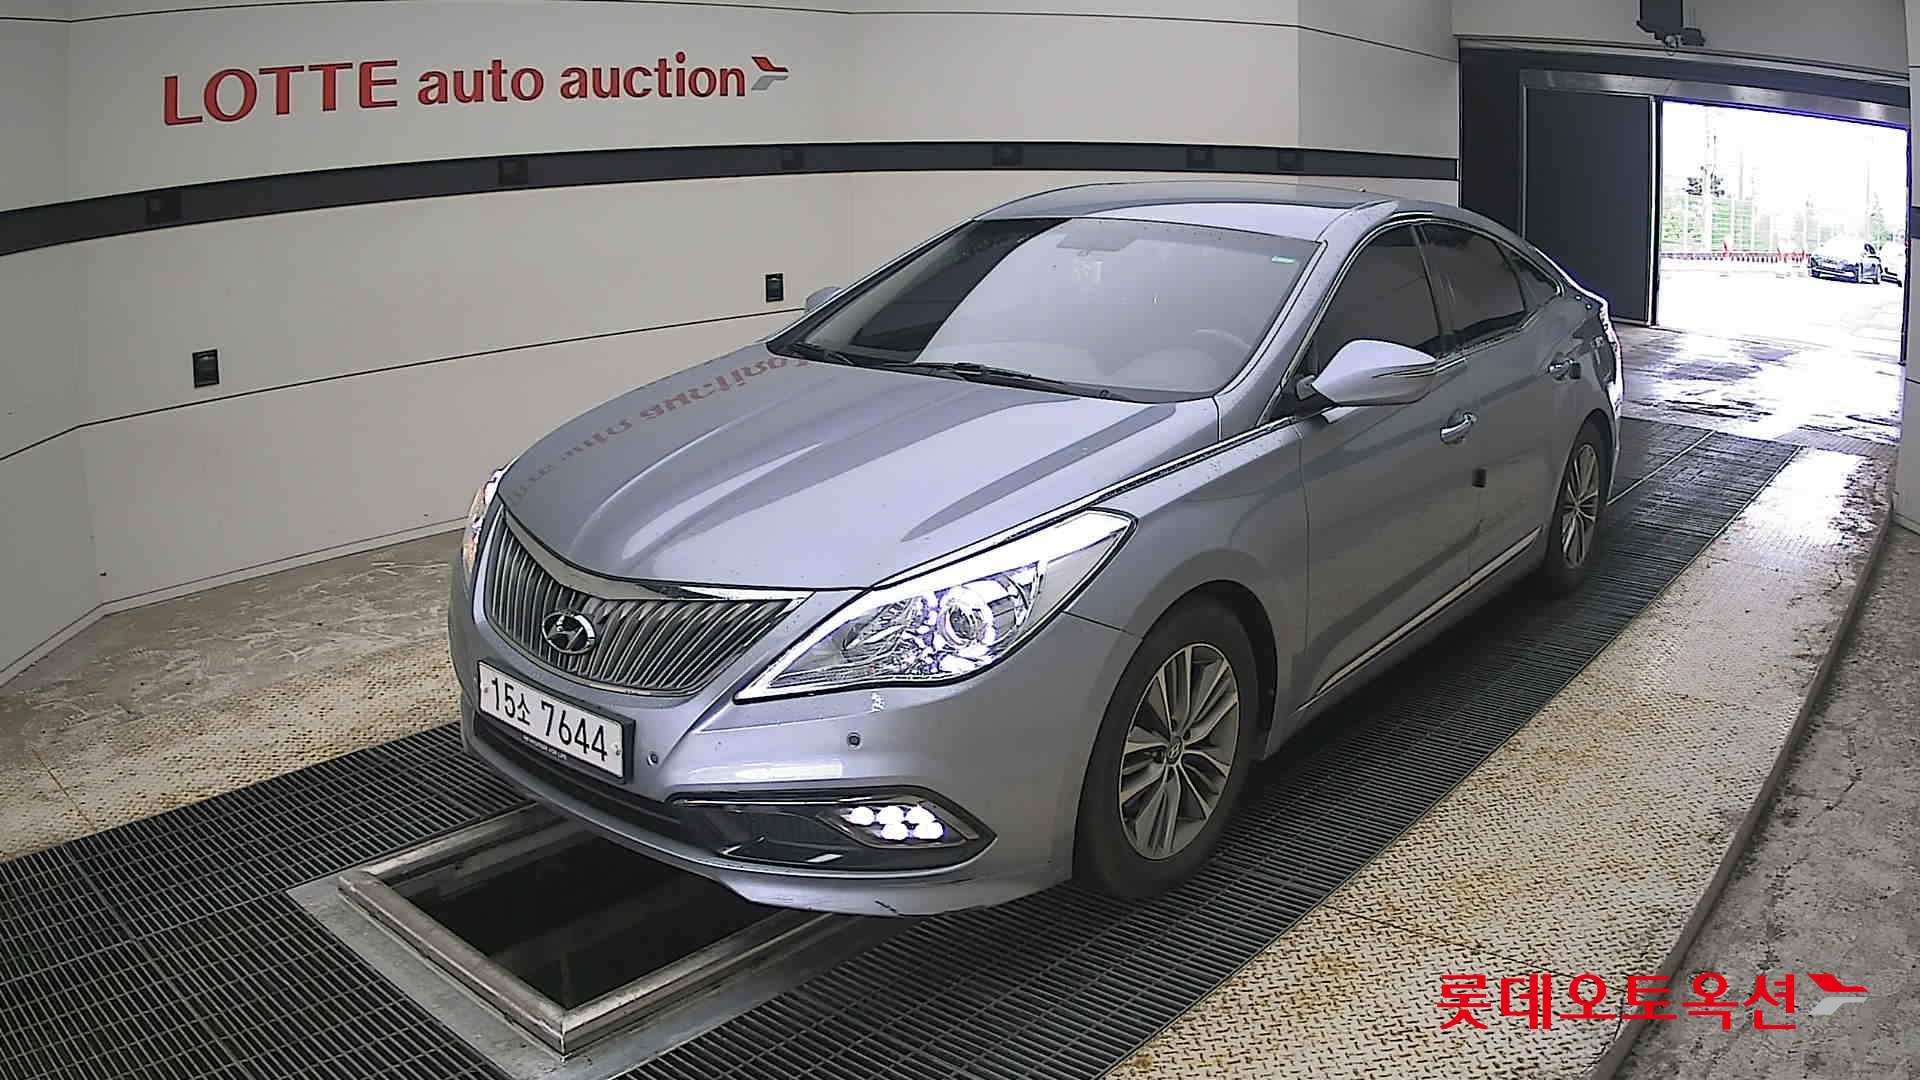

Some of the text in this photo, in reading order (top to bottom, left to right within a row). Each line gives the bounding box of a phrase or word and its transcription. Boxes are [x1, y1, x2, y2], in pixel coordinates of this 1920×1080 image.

[163, 51, 748, 127] LOTTE auto auction
[491, 677, 531, 726] 15소
[540, 701, 608, 762] 7644
